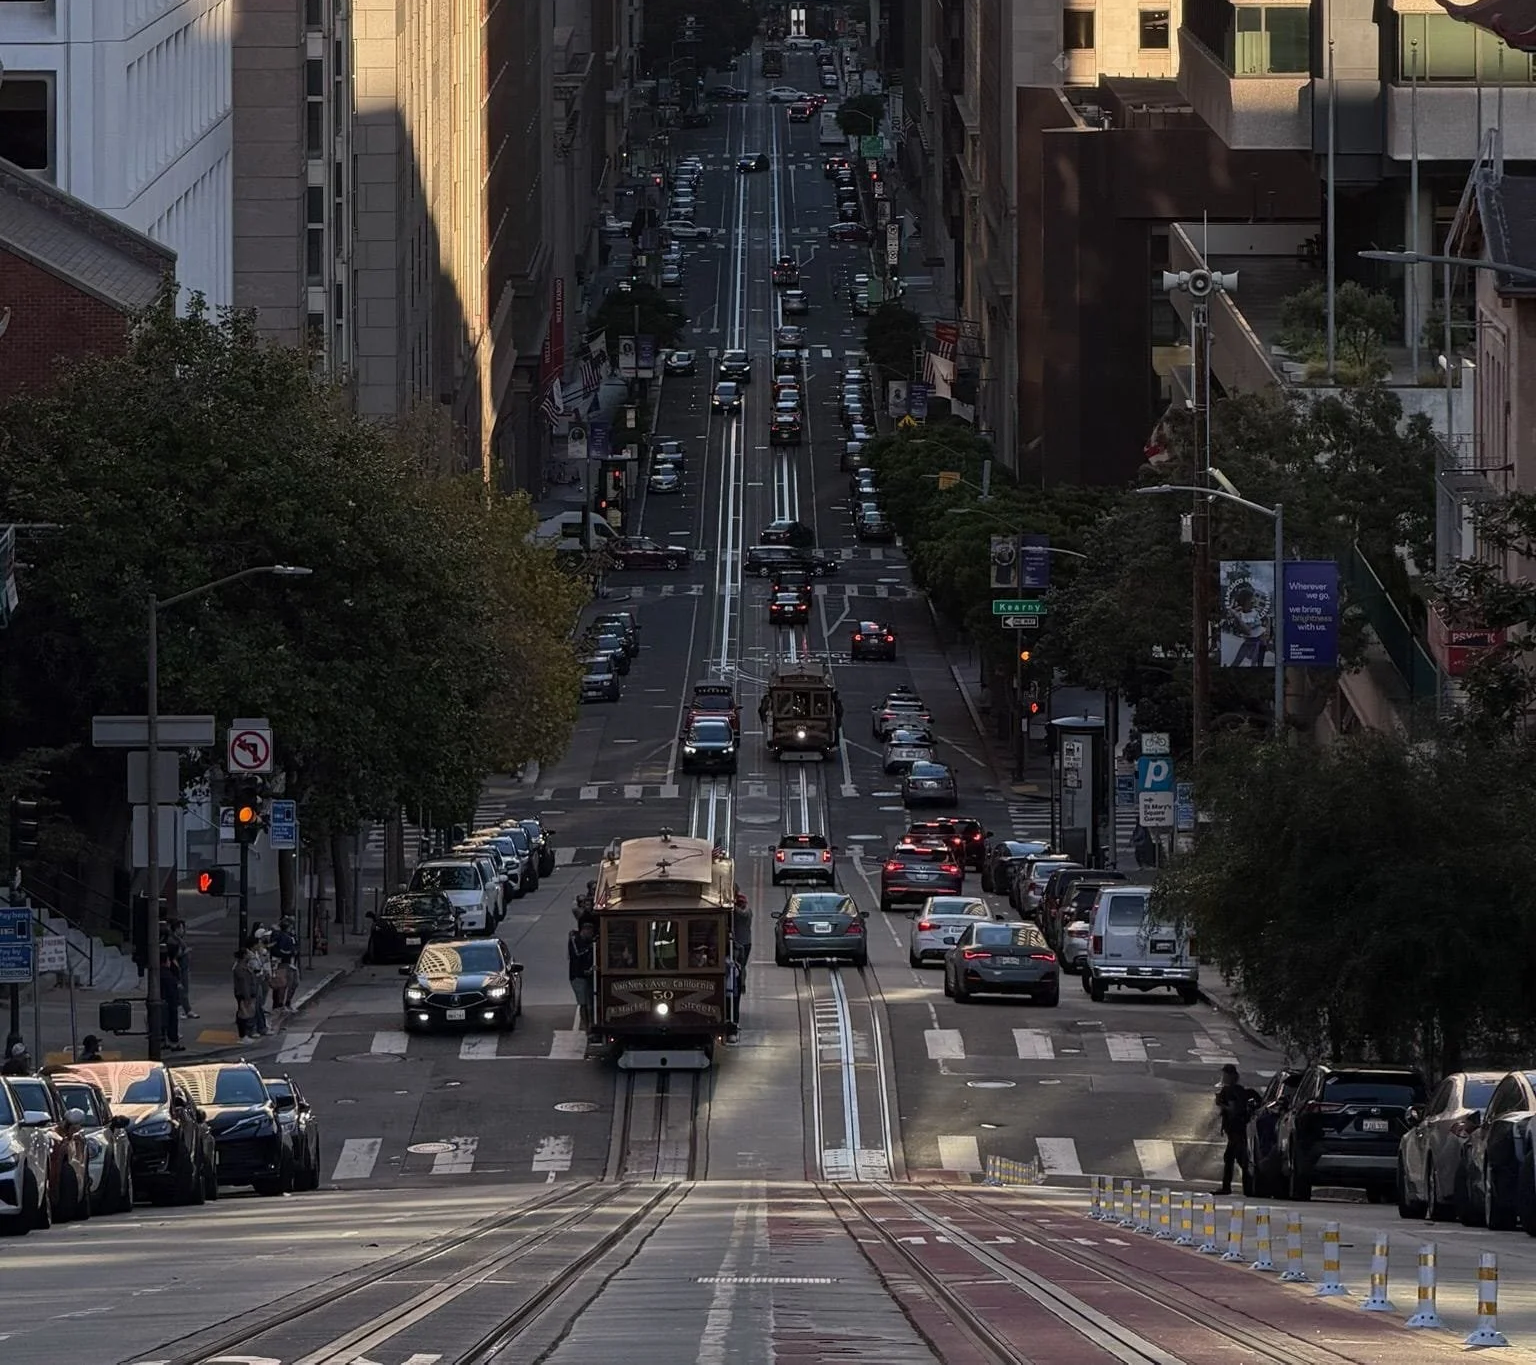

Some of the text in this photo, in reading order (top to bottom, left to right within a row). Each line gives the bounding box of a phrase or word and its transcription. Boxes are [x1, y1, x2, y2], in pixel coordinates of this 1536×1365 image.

[1288, 582, 1327, 591] Wherever
[999, 603, 1041, 612] Kearny
[1302, 605, 1322, 615] bring
[1292, 614, 1333, 623] brightness
[1297, 623, 1315, 631] with
[1151, 803, 1172, 811] Mary's
[649, 979, 667, 988] Ave
[673, 980, 714, 991] California
[652, 990, 673, 1000] 50
[680, 1002, 717, 1014] Streets
